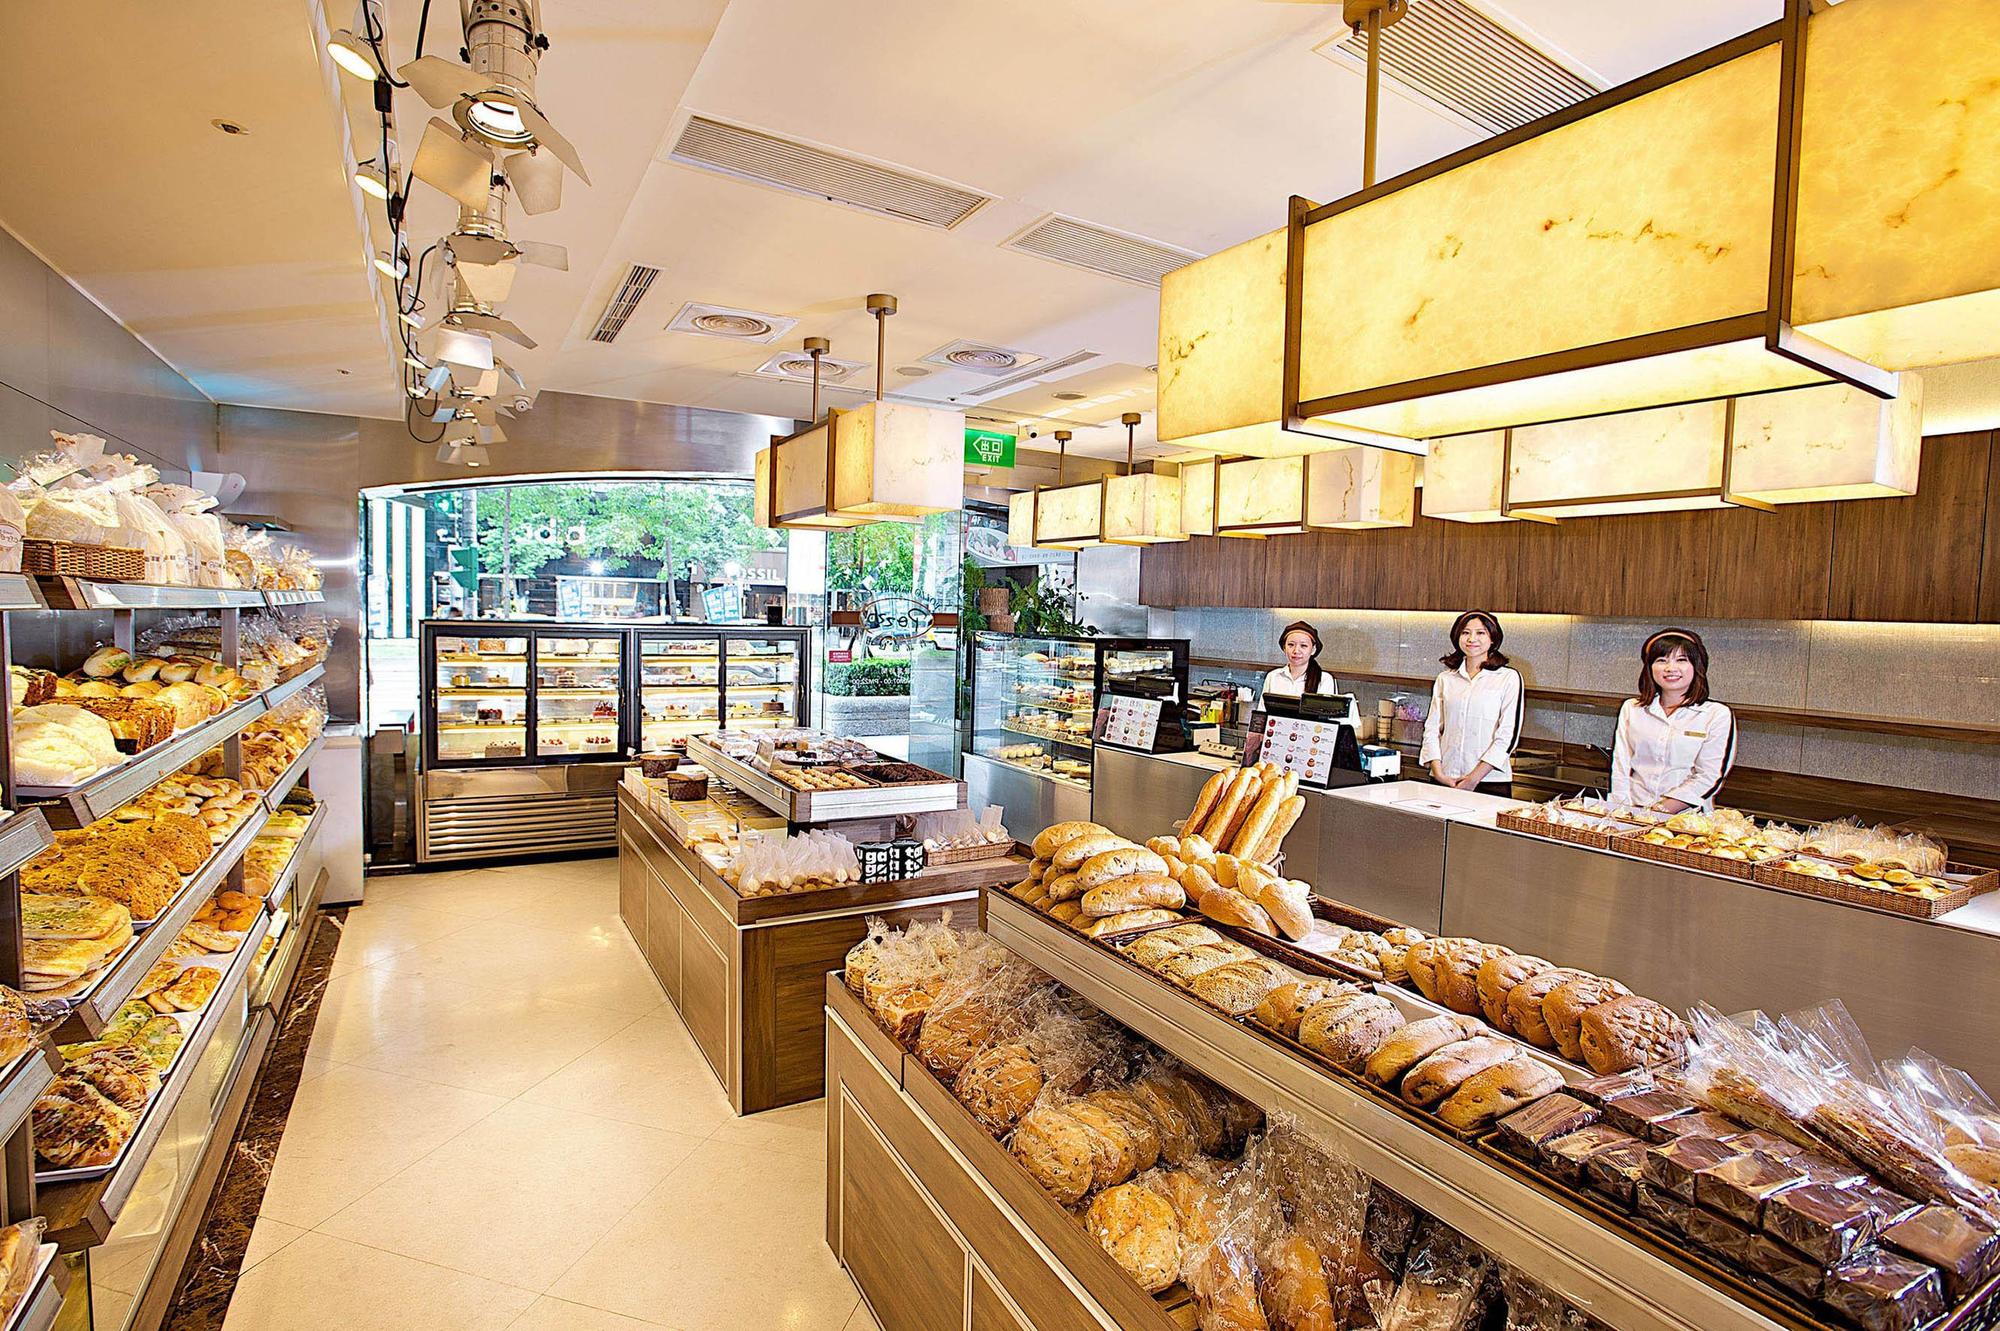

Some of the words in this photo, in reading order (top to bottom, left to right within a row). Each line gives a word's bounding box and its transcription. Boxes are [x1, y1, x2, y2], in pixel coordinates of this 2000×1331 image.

[980, 441, 1001, 453] 出口
[981, 454, 1001, 463] EXIT
[739, 568, 781, 580] OSSIL
